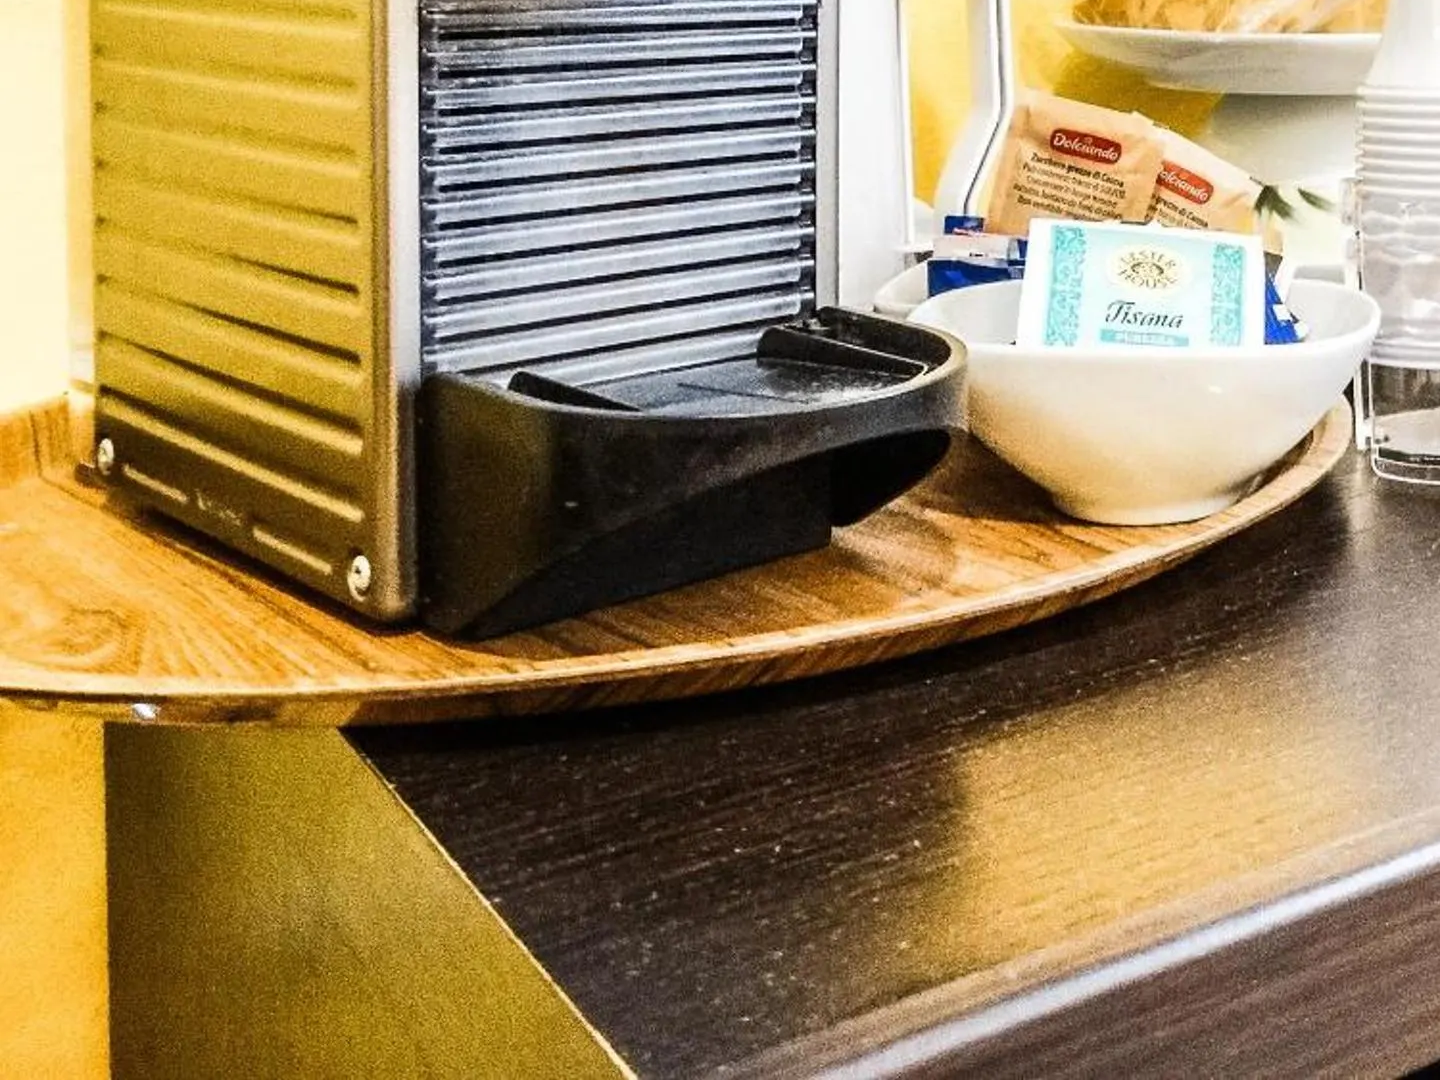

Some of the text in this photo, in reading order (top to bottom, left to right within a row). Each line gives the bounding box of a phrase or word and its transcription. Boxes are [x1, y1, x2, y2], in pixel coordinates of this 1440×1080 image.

[1053, 130, 1119, 161] Dolciando
[1159, 170, 1209, 202] olciando
[1105, 299, 1184, 329] Tisana
